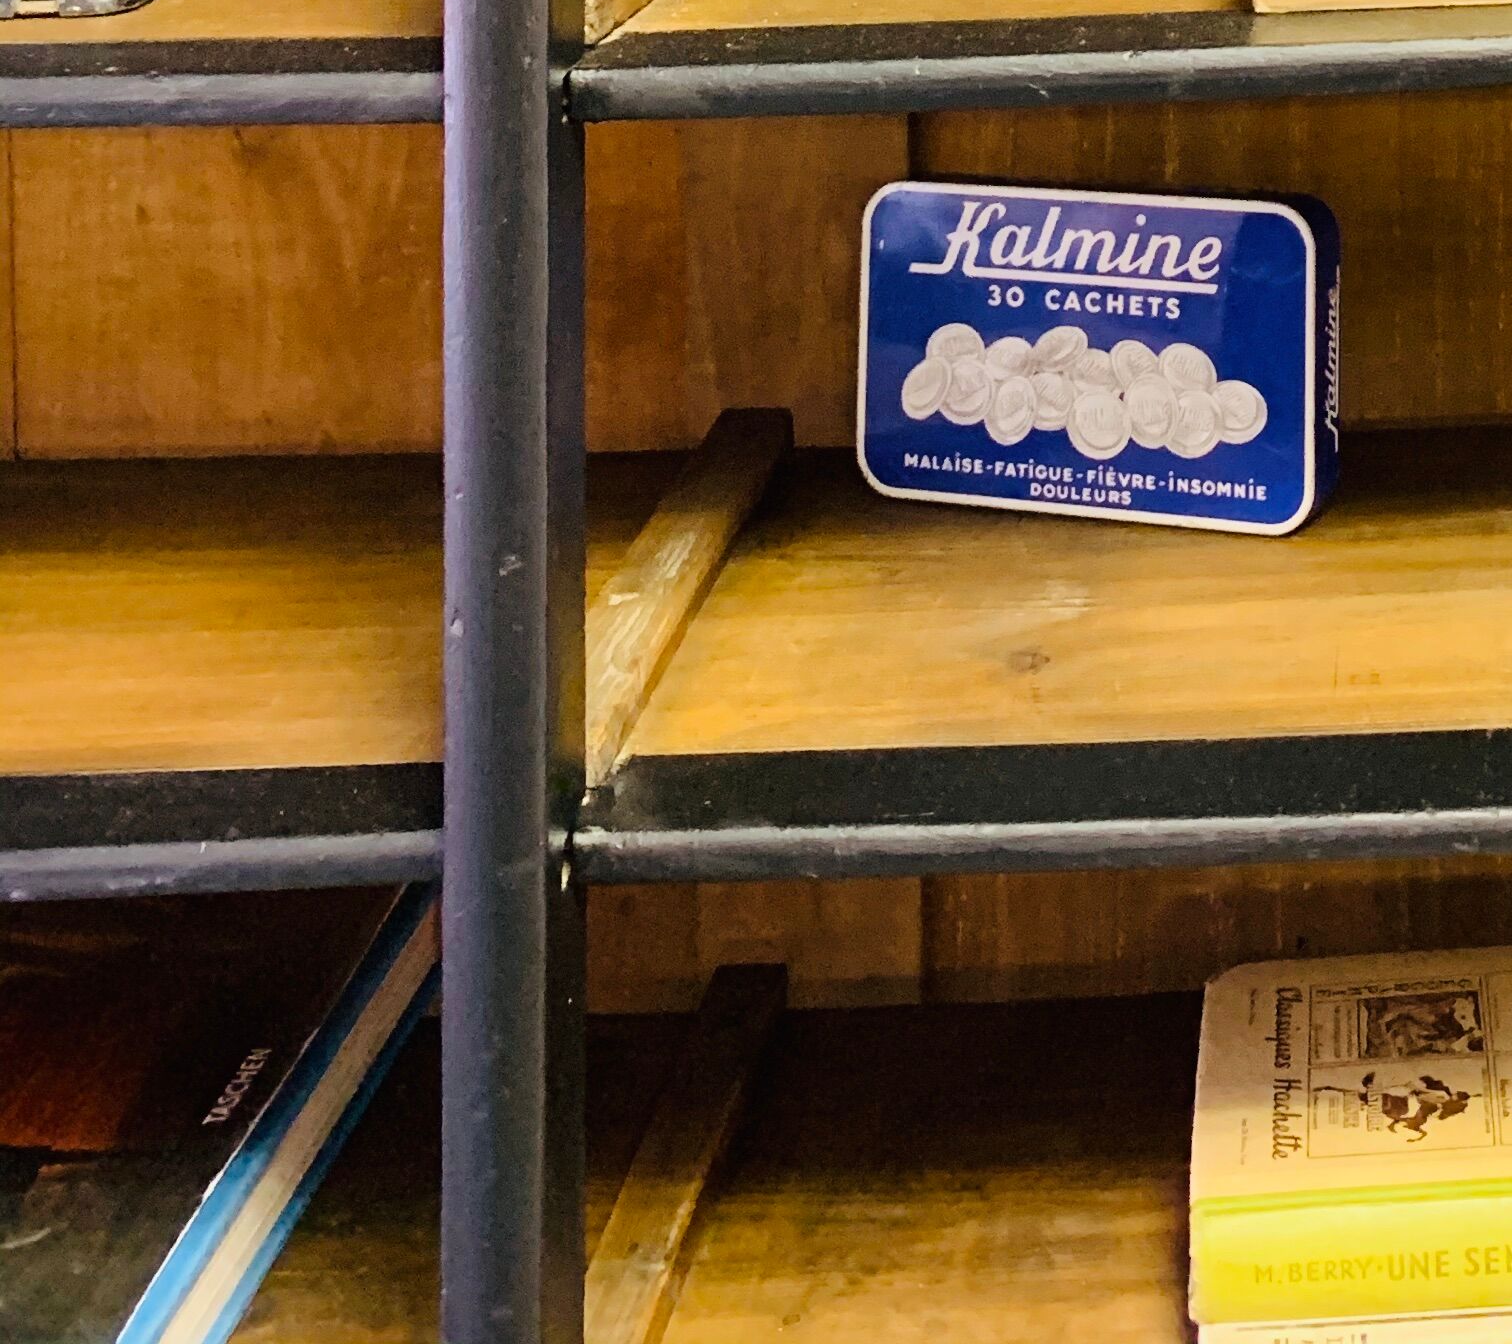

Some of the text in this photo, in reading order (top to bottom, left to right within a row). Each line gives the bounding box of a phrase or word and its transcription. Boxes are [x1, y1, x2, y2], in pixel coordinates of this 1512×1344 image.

[908, 201, 1223, 294] Kalmine
[987, 284, 1181, 320] 30 CACHETS
[1030, 482, 1132, 506] DOULEURS
[1271, 1078, 1303, 1160] Hachette
[1388, 1249, 1450, 1281] UNE
